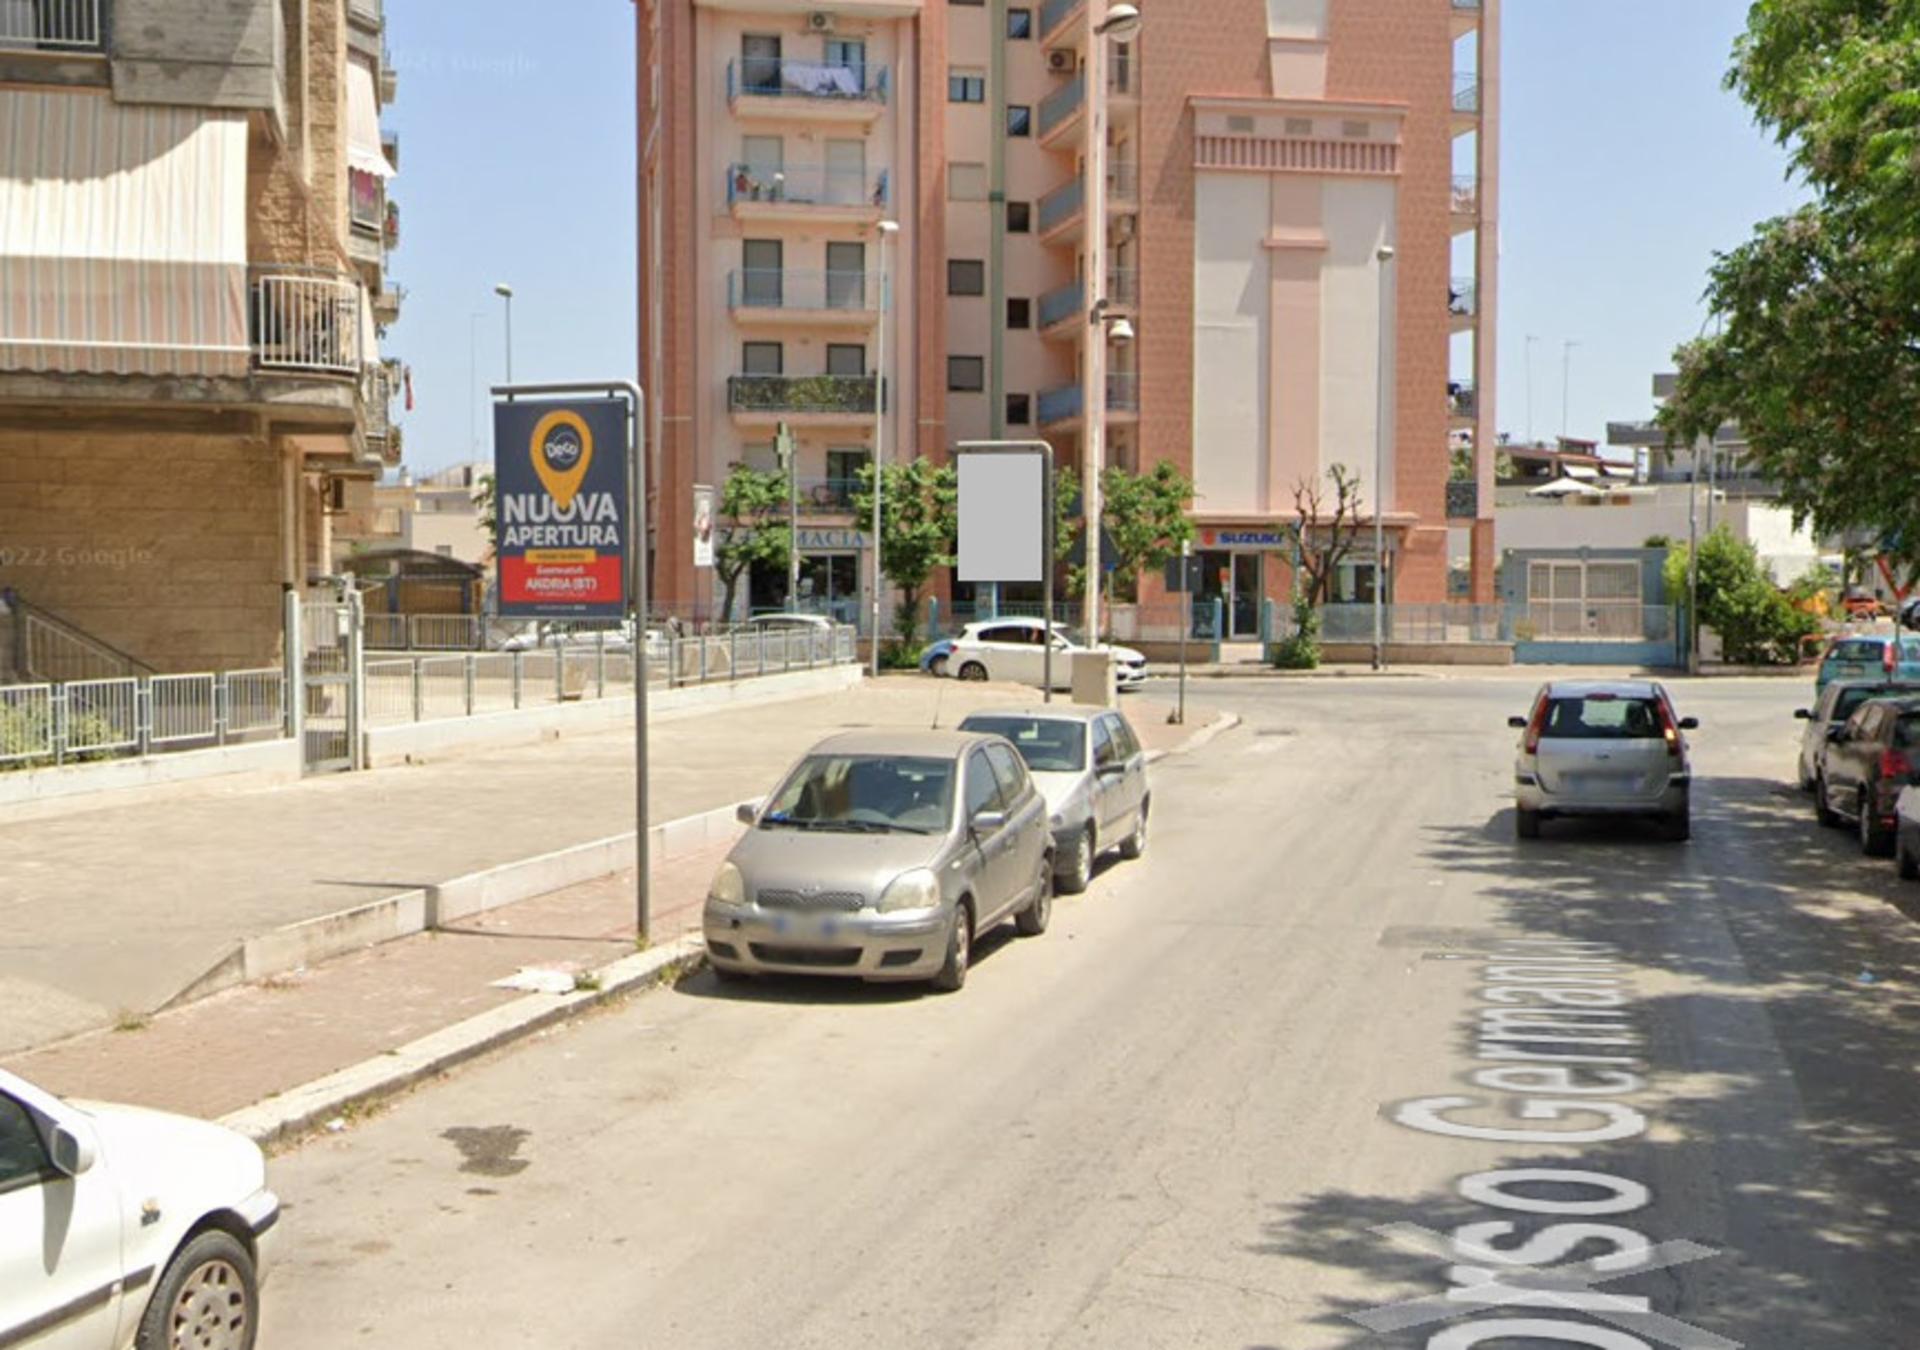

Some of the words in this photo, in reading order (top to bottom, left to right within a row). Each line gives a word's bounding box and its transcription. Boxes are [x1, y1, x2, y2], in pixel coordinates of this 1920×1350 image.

[503, 493, 619, 522] NUOVA
[503, 525, 619, 545] APERTURA
[1220, 532, 1282, 544] SUZUKI
